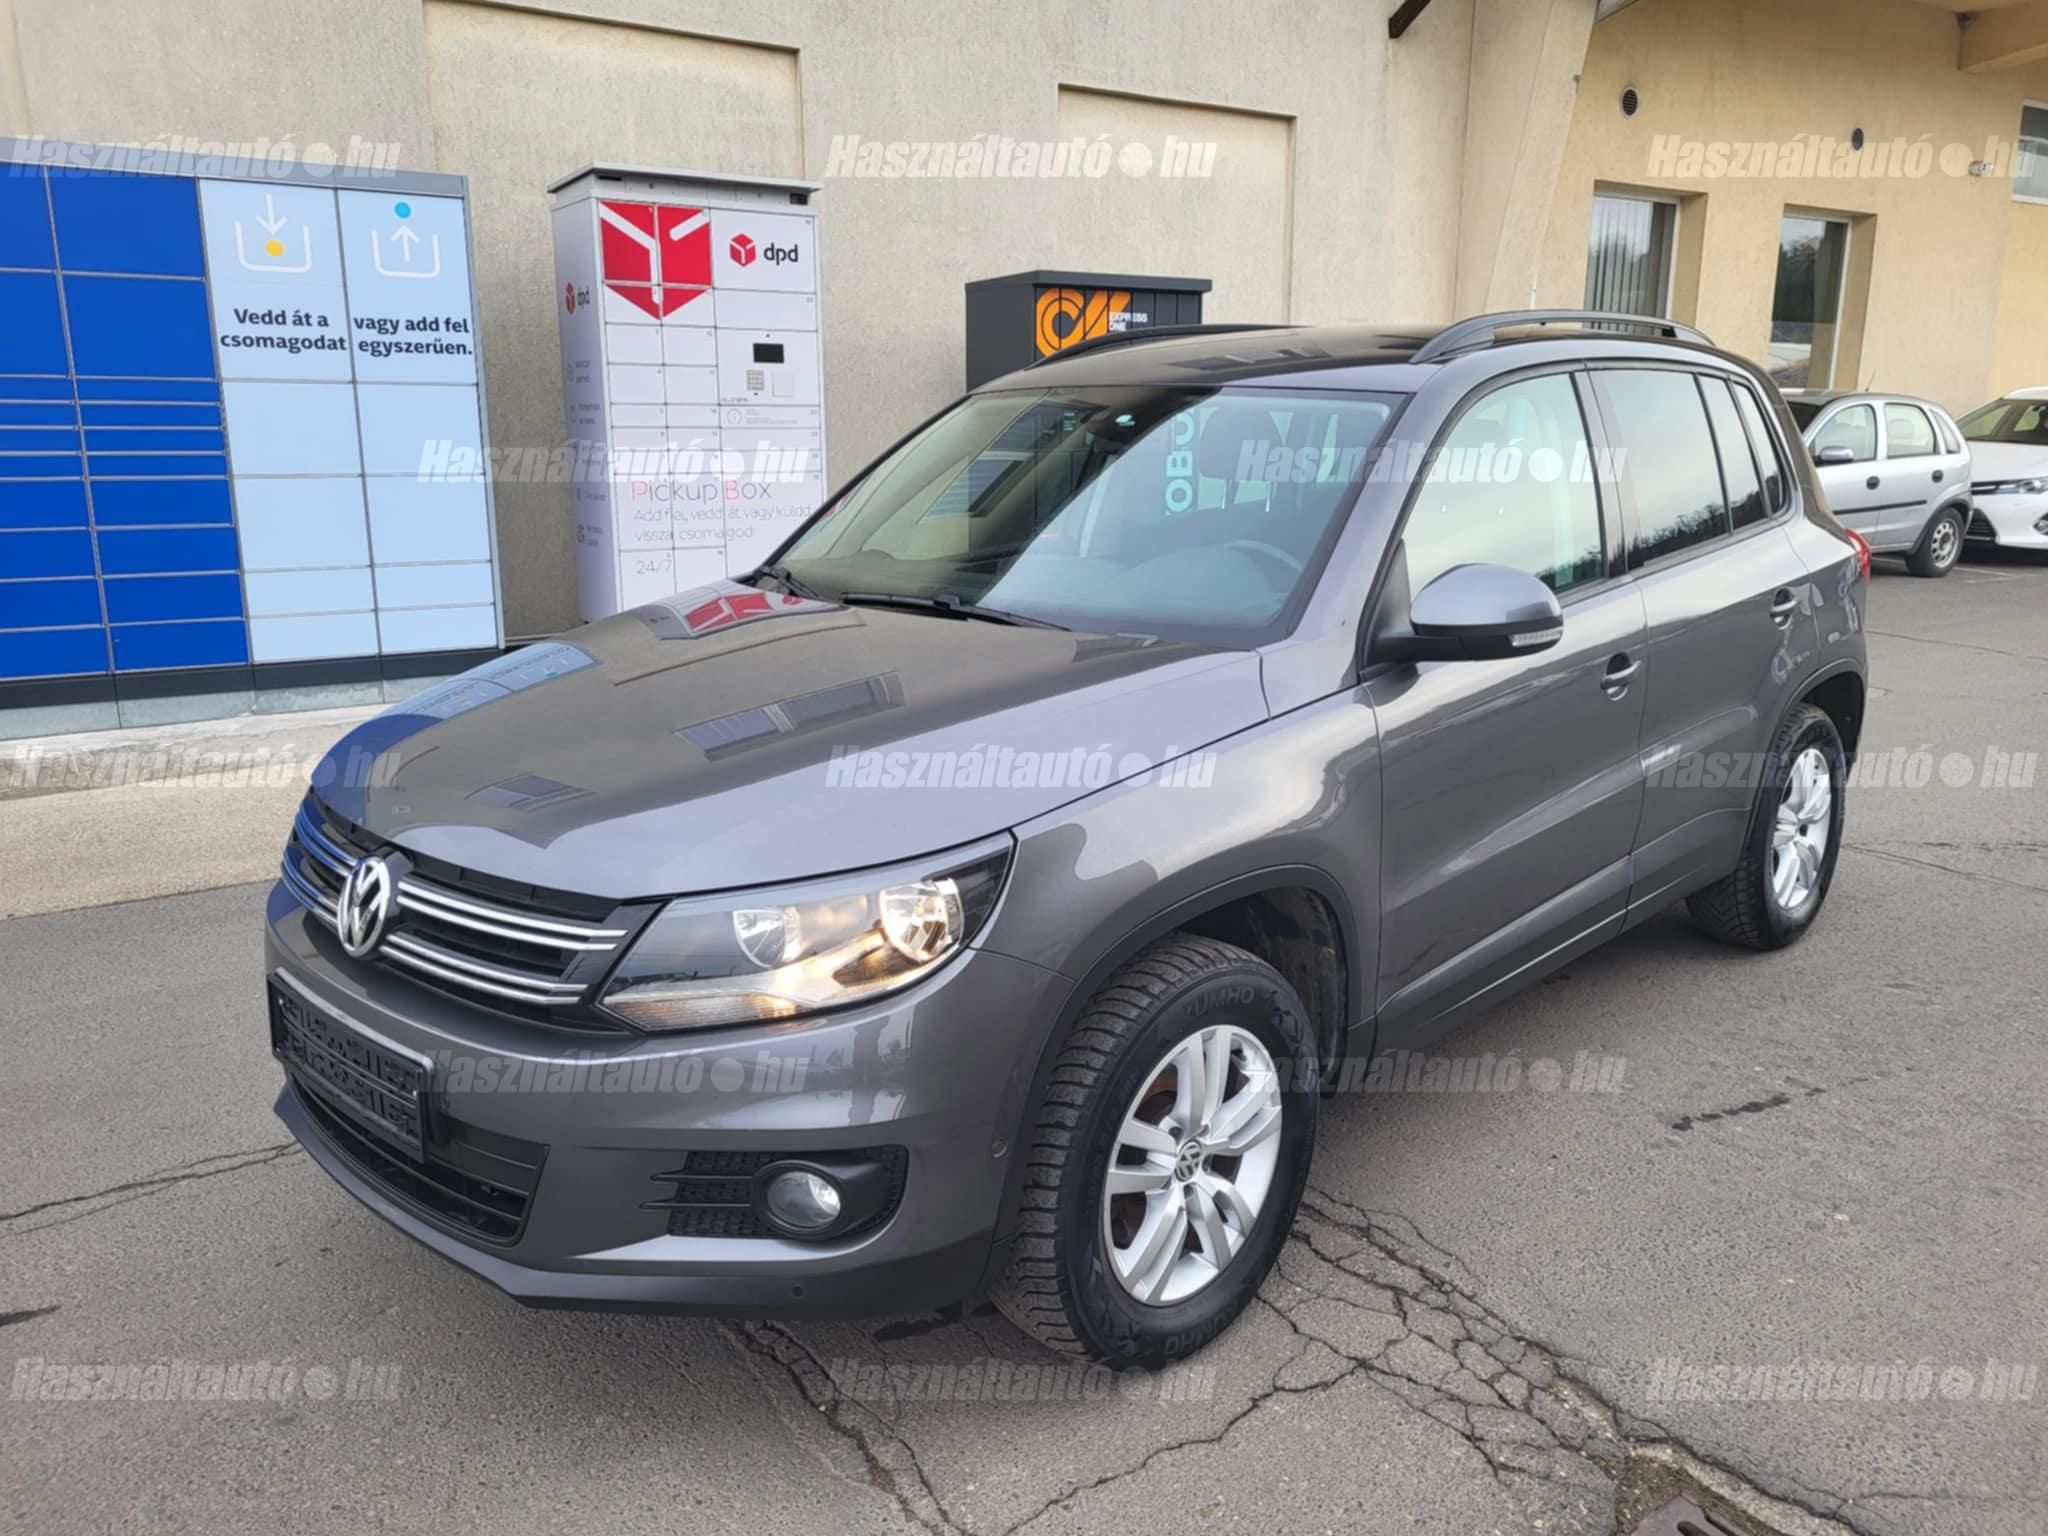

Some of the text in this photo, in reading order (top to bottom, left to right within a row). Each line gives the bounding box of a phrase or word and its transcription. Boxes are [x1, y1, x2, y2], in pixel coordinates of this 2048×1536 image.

[763, 242, 798, 265] dpd
[233, 308, 329, 327] Vedd át a
[353, 316, 469, 335] vagy add fel
[220, 334, 347, 354] csomagodat
[636, 560, 672, 574] 24/7
